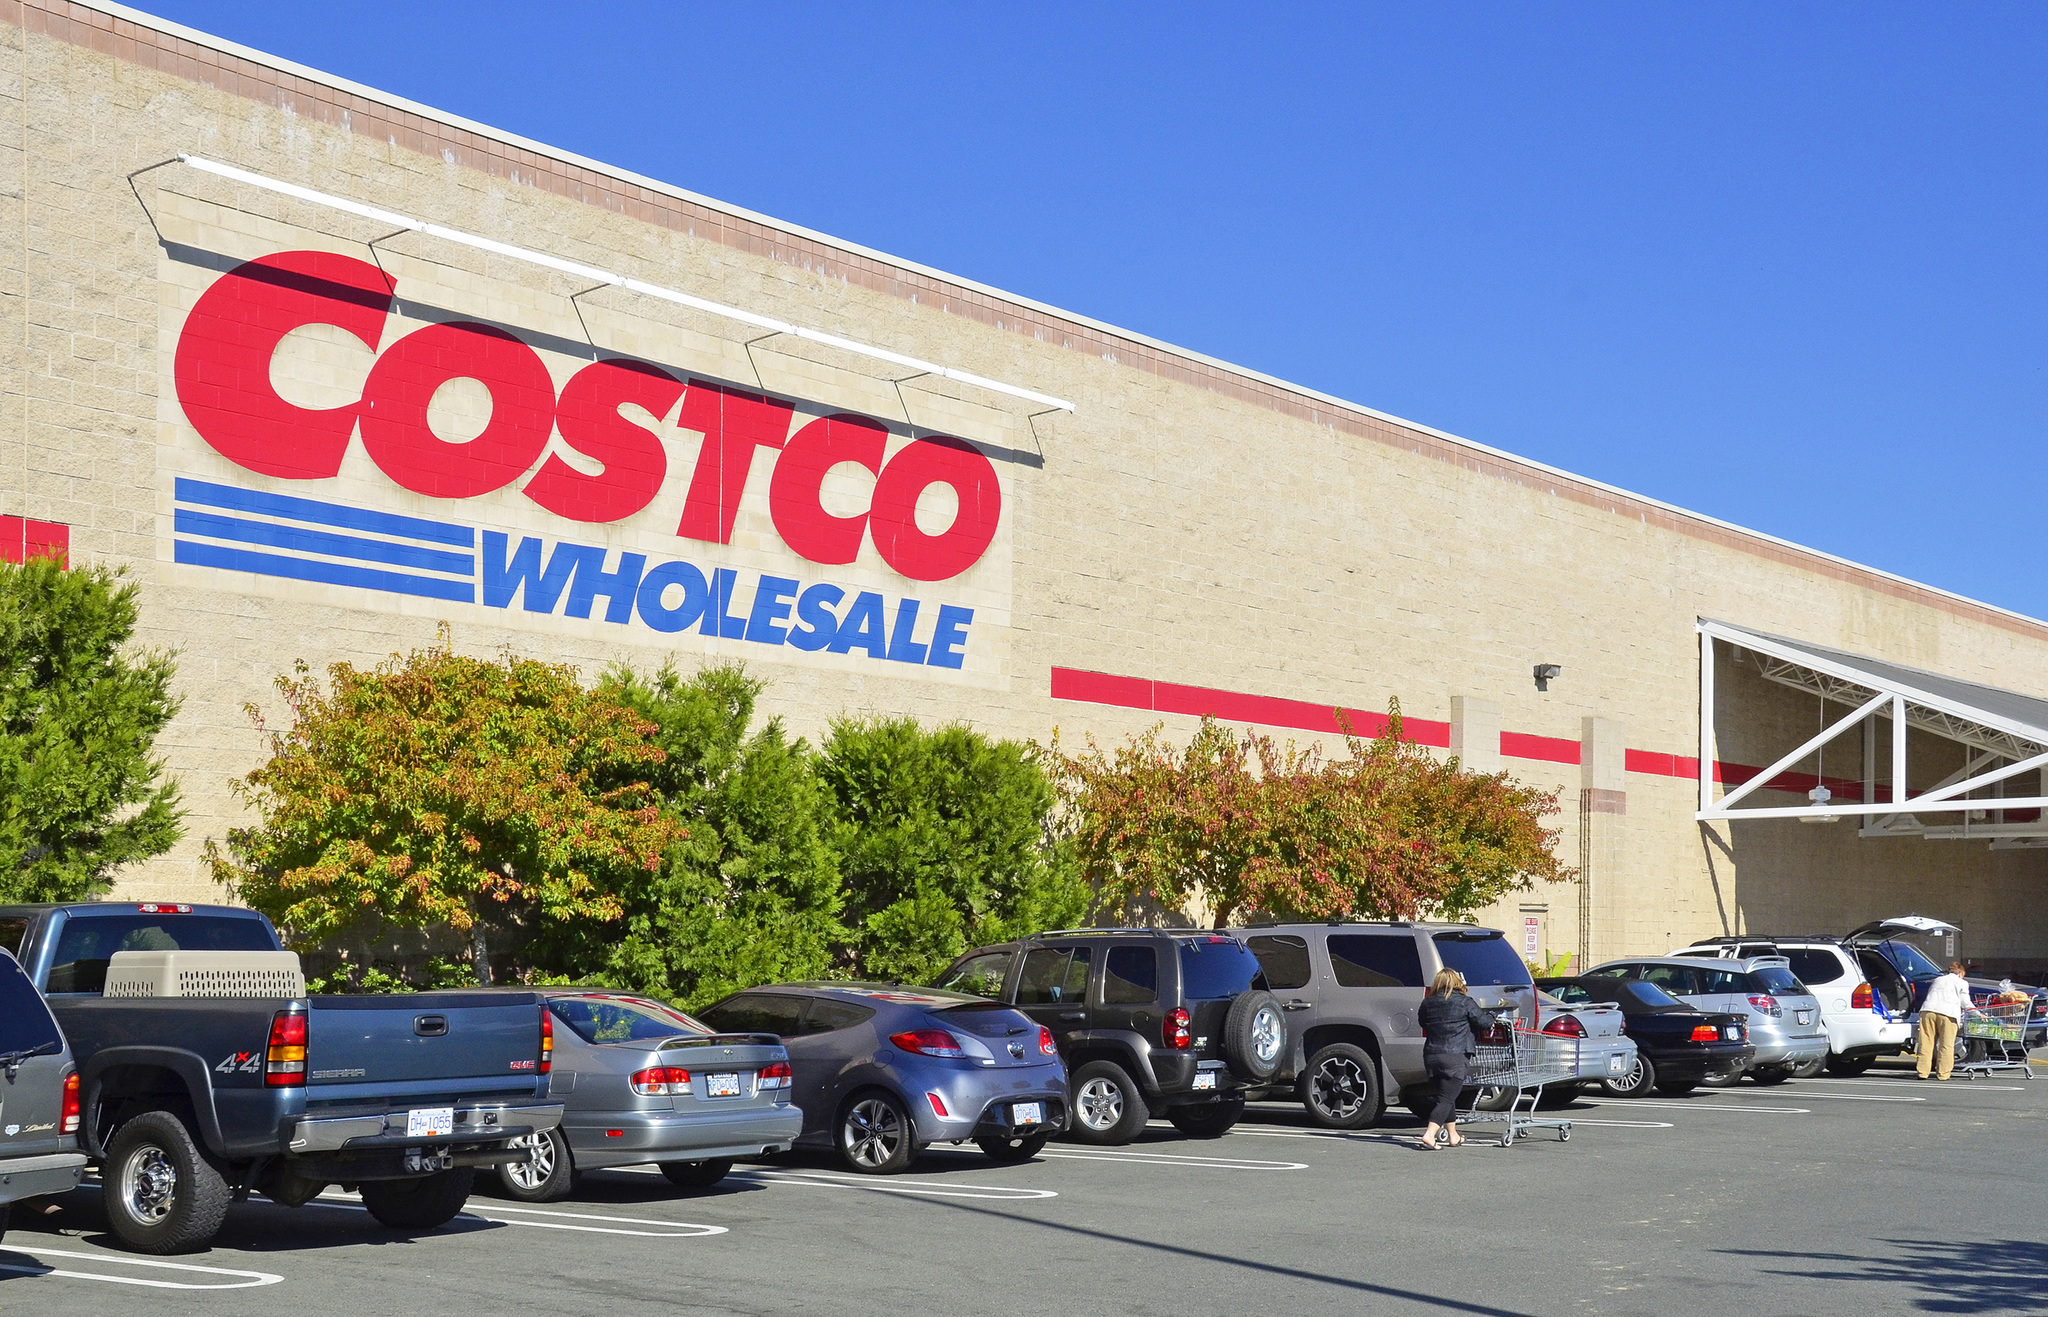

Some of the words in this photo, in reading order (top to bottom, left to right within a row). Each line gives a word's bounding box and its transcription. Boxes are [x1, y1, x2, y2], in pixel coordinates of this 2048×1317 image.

[174, 250, 1001, 581] COSTCO
[483, 530, 974, 669] WHOLESALE
[312, 1068, 366, 1079] SIERRA
[510, 1061, 535, 1070] GMC
